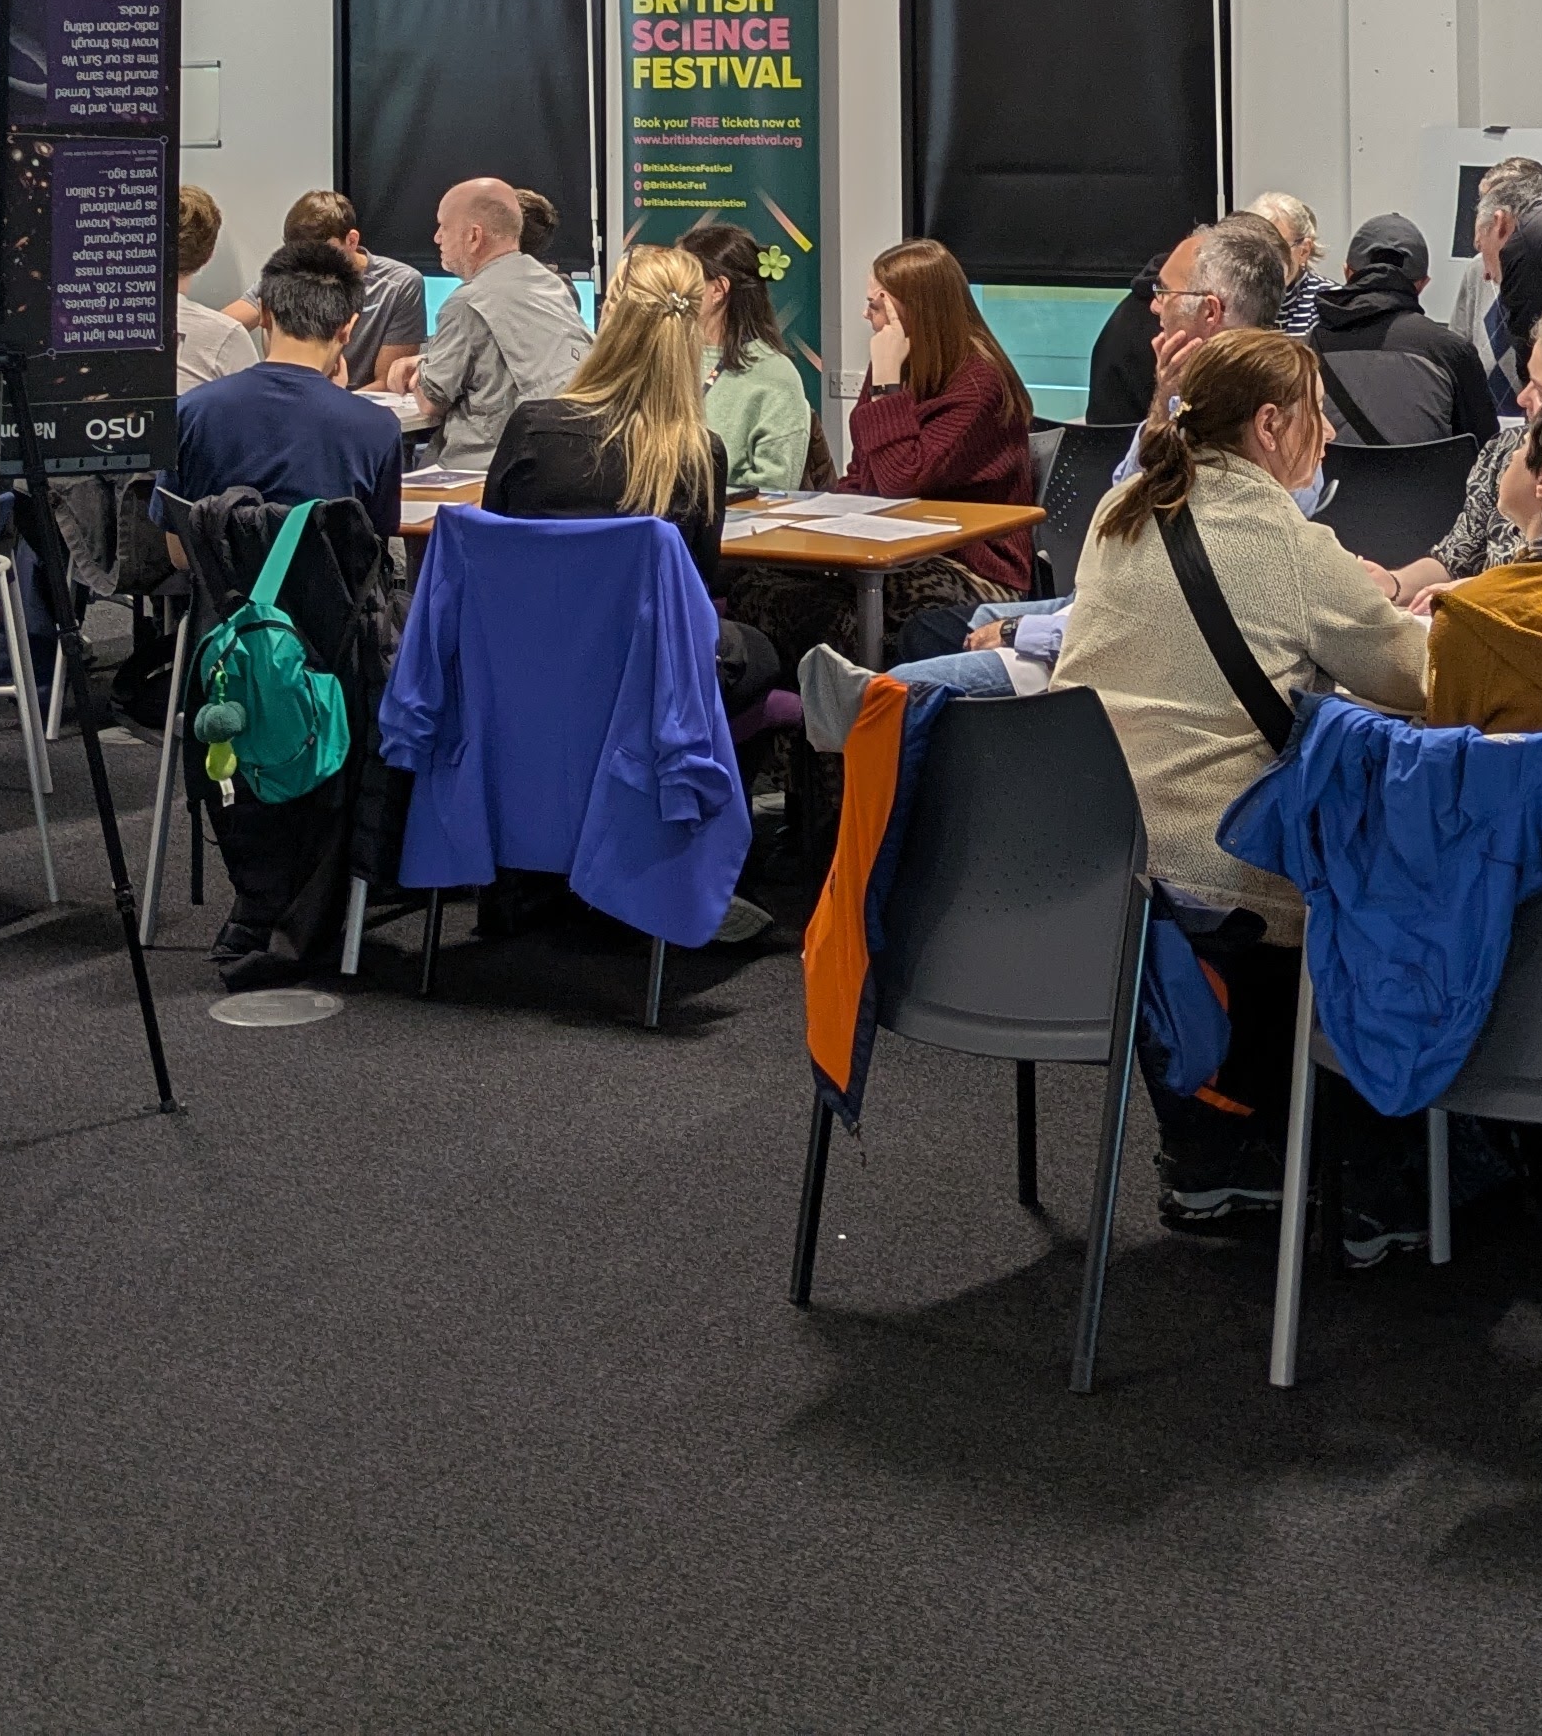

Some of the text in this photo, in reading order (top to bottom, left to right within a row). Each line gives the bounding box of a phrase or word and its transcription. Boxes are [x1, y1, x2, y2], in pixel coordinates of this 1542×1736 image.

[149, 6, 159, 16] of
[64, 21, 158, 34] radio-carbon dating
[632, 18, 790, 51] SCIENCE
[71, 37, 158, 49] know this through
[62, 56, 78, 66] We
[105, 55, 120, 64] our
[123, 55, 134, 63] as
[137, 54, 158, 64] time
[76, 71, 158, 81] around the same
[633, 56, 802, 88] FESTIVAL
[55, 88, 90, 99] formed
[133, 86, 158, 97] other
[70, 104, 86, 114] the
[89, 103, 107, 114] and
[140, 102, 157, 113] The
[634, 117, 801, 130] Book your FREE tickets now at
[634, 135, 802, 148] www.britishsciencefestival.org
[130, 167, 157, 178] years
[643, 164, 732, 172] BritishScienceFestival
[99, 186, 115, 197] 4.5
[643, 182, 706, 190] @BritishSciFest
[66, 187, 95, 198] billion
[80, 199, 157, 213] as gravitational
[76, 219, 110, 228] known
[84, 233, 156, 245] of background
[73, 249, 156, 260] warps the shape
[75, 265, 156, 276] enormous mass
[58, 283, 91, 293] whose
[125, 281, 156, 292] MACS
[109, 297, 119, 309] of
[122, 297, 156, 306] cluster
[72, 313, 155, 324] this is a massive
[64, 329, 156, 343] When the light left
